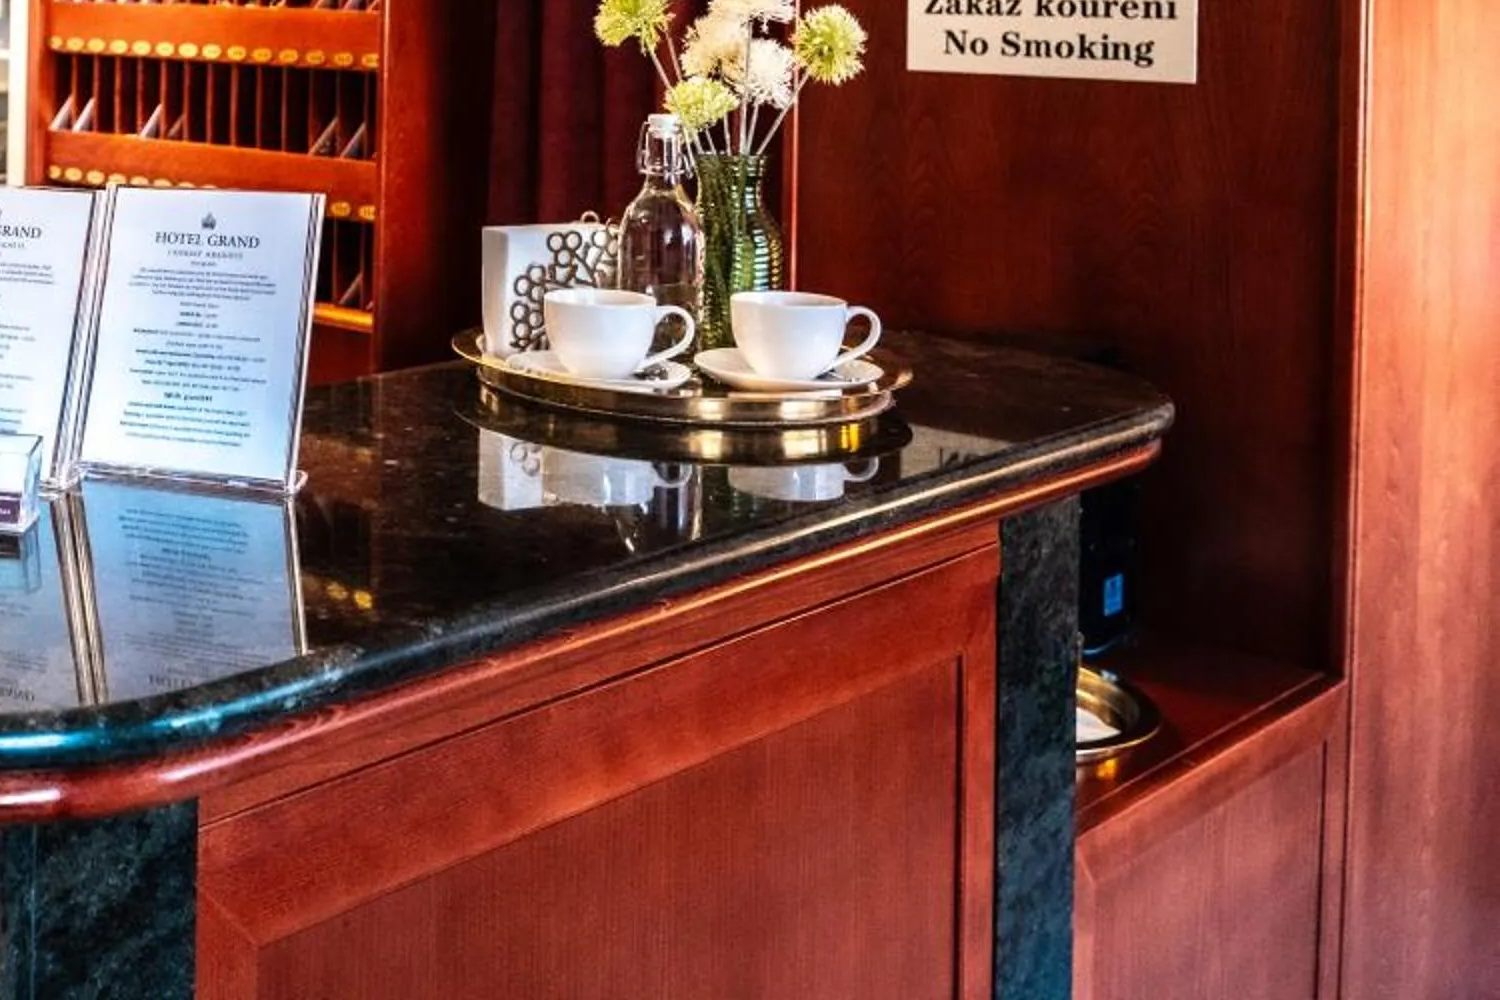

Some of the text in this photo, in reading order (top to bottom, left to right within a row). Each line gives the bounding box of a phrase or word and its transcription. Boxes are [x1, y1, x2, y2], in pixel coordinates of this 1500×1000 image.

[943, 30, 1155, 68] No Smoking
[155, 231, 260, 248] HOTEL GRAND
